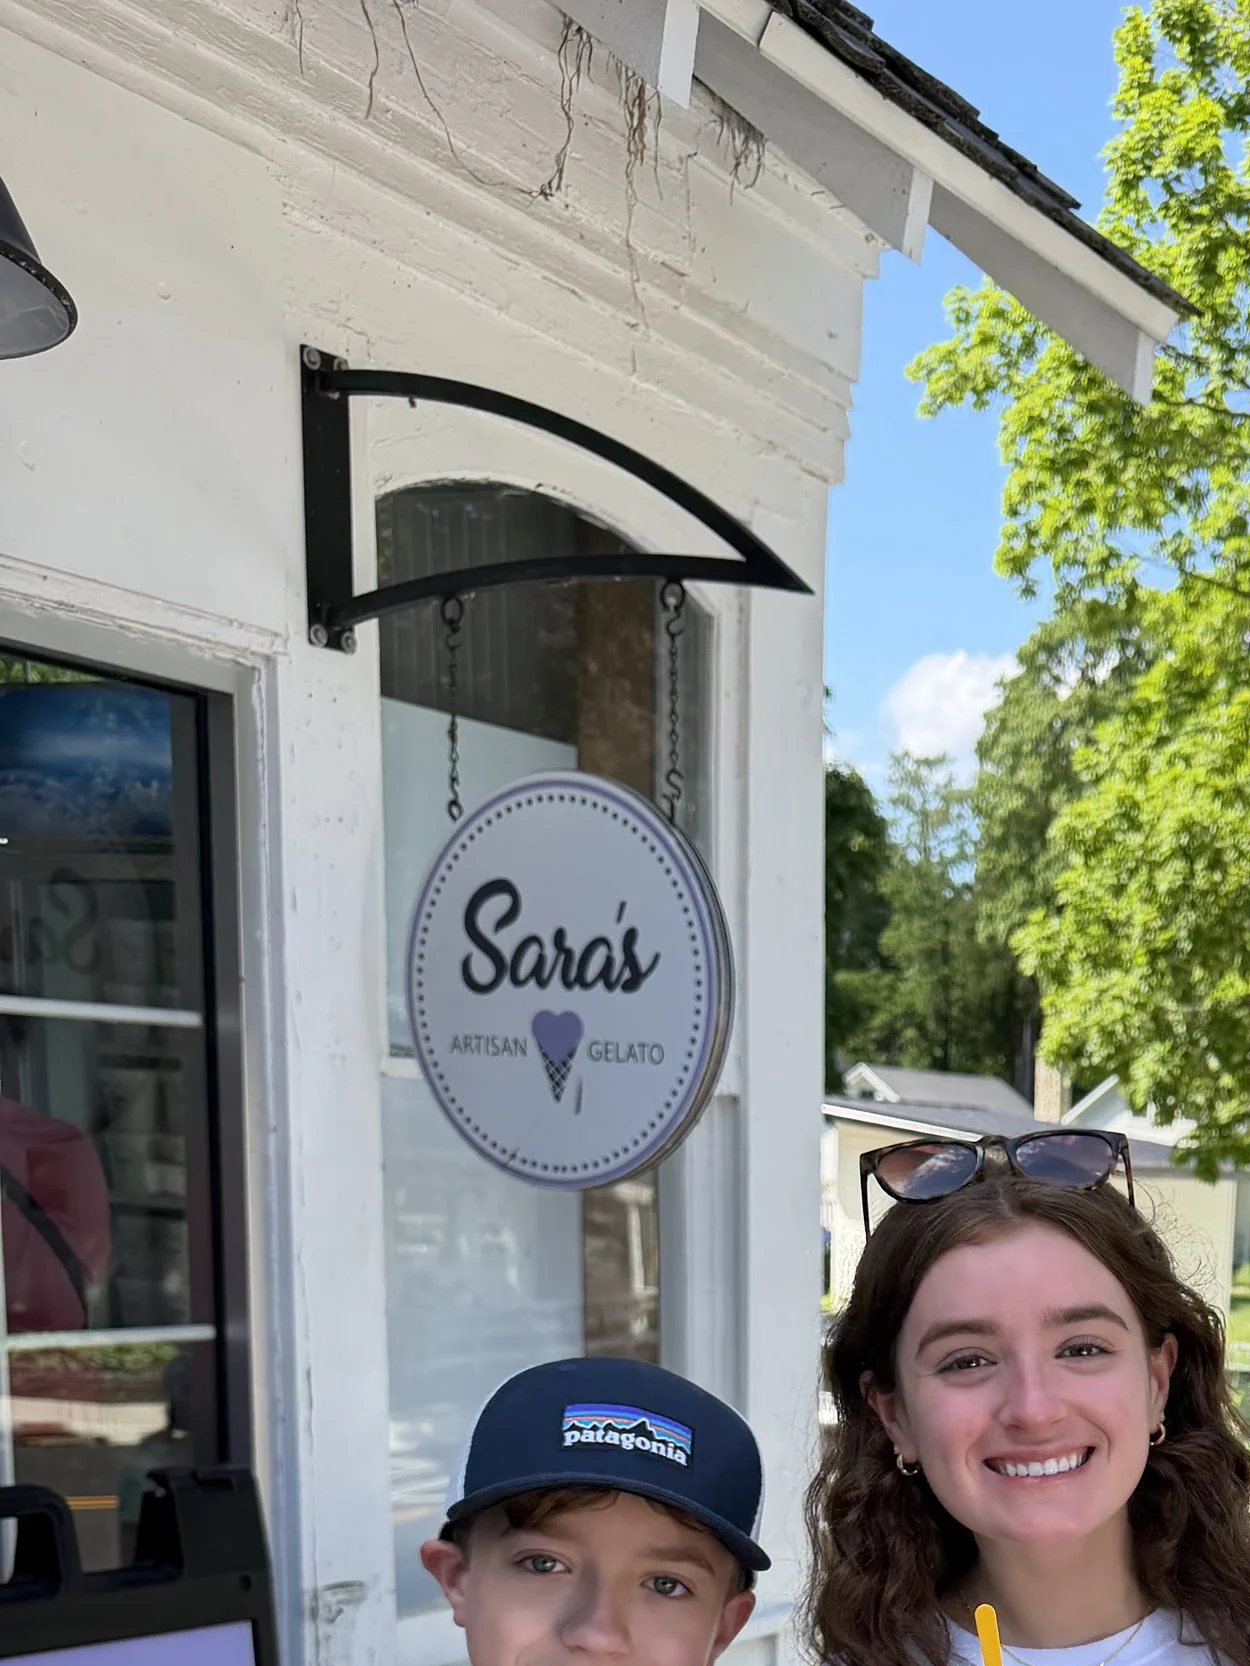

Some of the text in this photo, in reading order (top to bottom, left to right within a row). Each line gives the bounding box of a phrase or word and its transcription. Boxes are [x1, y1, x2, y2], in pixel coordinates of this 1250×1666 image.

[461, 877, 662, 994] Sara's
[450, 1034, 665, 1065] ARTISAN GELATO
[562, 1428, 688, 1467] patagonia
